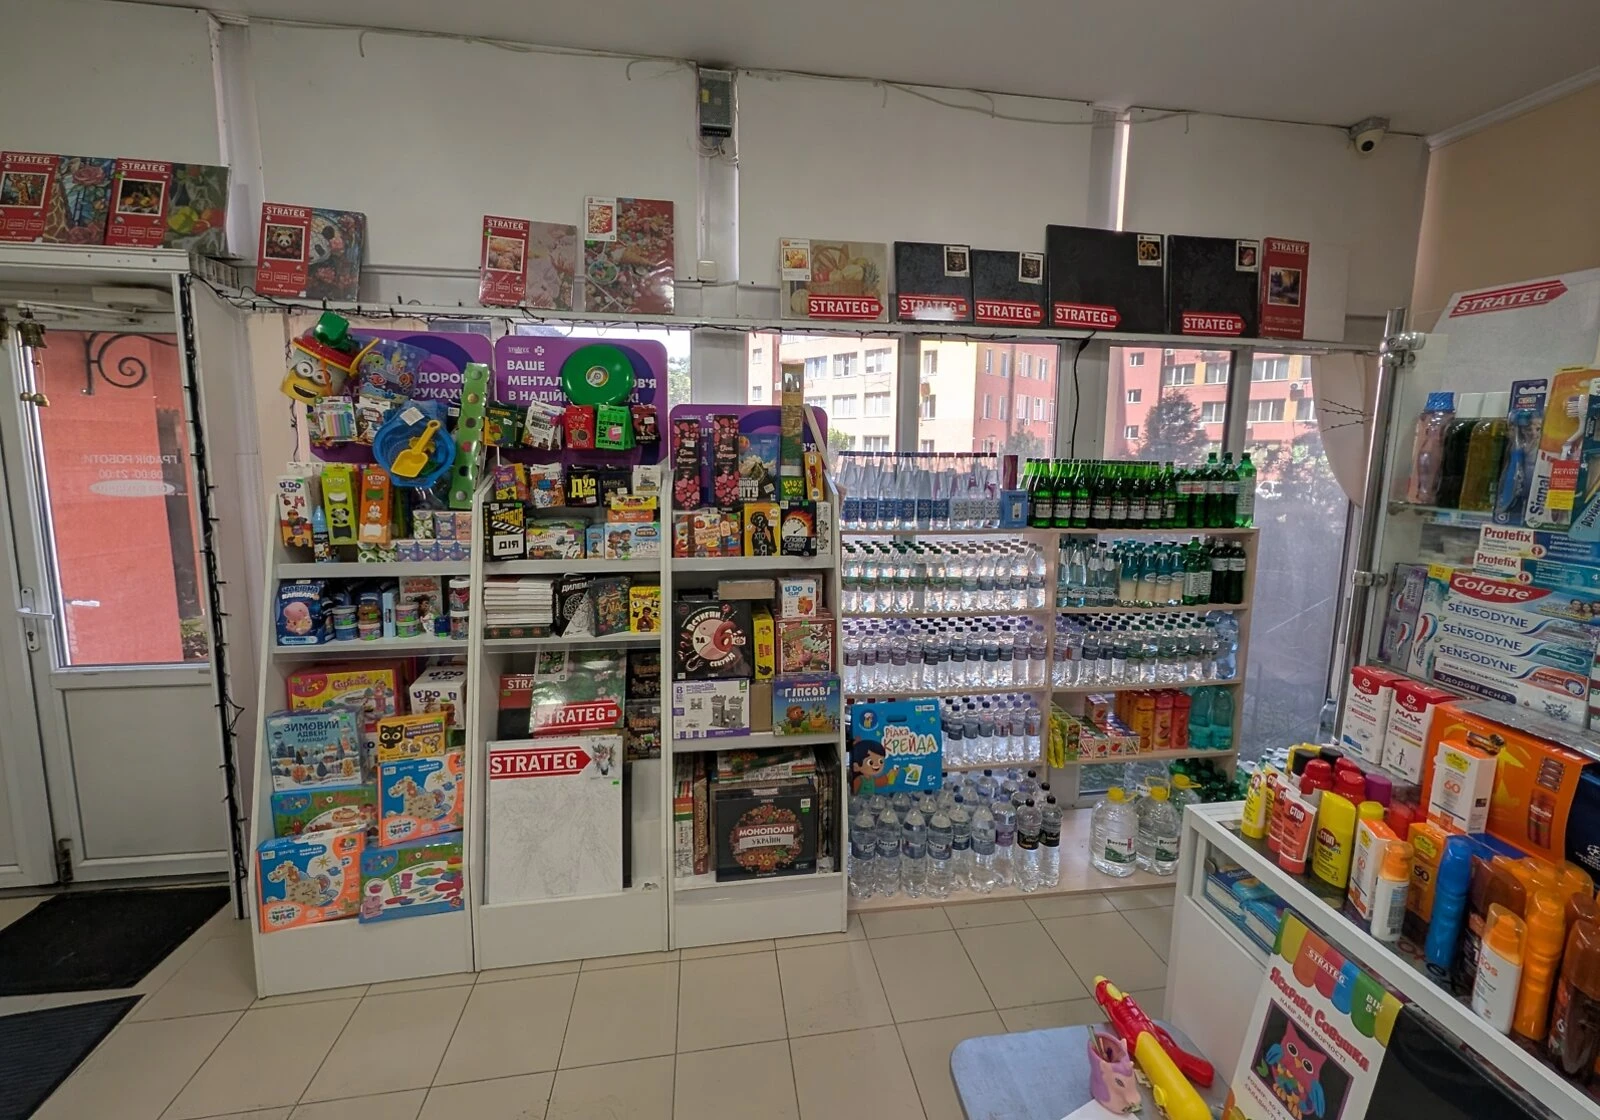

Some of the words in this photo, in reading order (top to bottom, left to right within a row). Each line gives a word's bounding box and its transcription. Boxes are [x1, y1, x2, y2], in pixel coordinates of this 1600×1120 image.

[6, 154, 50, 164] STRATEG
[121, 162, 166, 172] STRATEG
[266, 206, 305, 217] STRATEG
[487, 219, 524, 231] STRATEG
[1272, 242, 1305, 254] STRATEG
[810, 301, 869, 314] STRATEG
[1456, 288, 1549, 312] STRATEG
[977, 304, 1032, 319] STRATEG
[1056, 308, 1108, 323] STRATEG
[1184, 317, 1233, 331] STRATEG
[507, 360, 545, 371] ВАШЕ
[507, 375, 563, 387] МЕНТАЛ
[508, 391, 517, 401] В
[1529, 474, 1551, 516] Signal
[1484, 527, 1531, 543] Protefix
[499, 540, 519, 549] ДІЯ
[1477, 553, 1517, 568] Protefix
[1454, 577, 1530, 600] Colgate
[686, 611, 722, 632] ВСТИГНИ
[1448, 602, 1529, 628] SENSODYNE
[1443, 623, 1522, 651] SENSODYNE
[1439, 644, 1518, 673] SENSODYNE
[507, 680, 533, 689] STRA
[784, 686, 831, 698] ГІПСОВІ
[1439, 673, 1480, 692] Здорові
[1482, 688, 1508, 701] ясна
[1354, 693, 1373, 705] MAX
[536, 707, 605, 725] STRATEG
[1395, 708, 1423, 725] MAX
[283, 719, 340, 732] ЗИМОВИЙ
[297, 730, 327, 738] АДВЕНТ
[883, 735, 936, 753] КРЕЙДА
[490, 752, 578, 774] STRATEG
[738, 825, 795, 837] МОНОПОЛІЯ
[1308, 949, 1346, 984] STRATEG
[1365, 994, 1383, 1012] ВІК
[1279, 997, 1297, 1016] НАБІР
[1297, 1014, 1310, 1030] ДЛЯ
